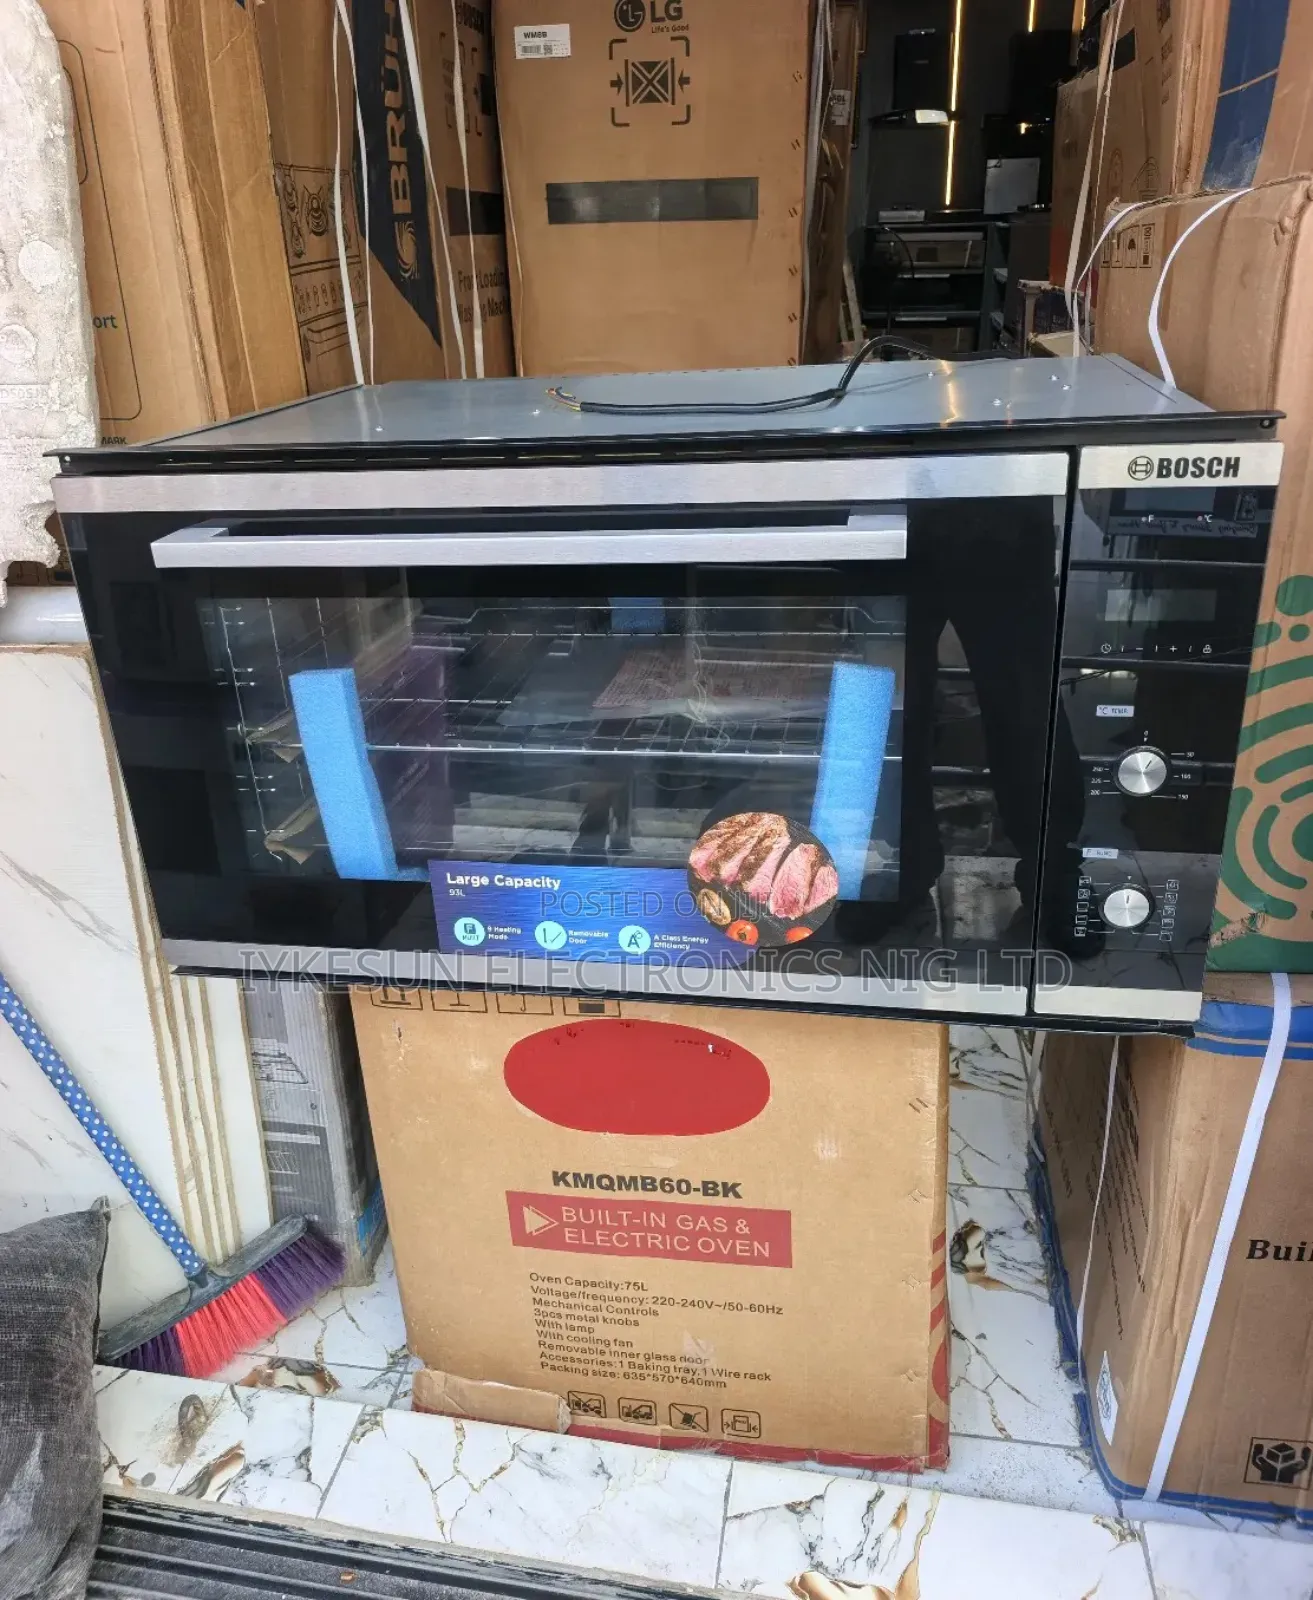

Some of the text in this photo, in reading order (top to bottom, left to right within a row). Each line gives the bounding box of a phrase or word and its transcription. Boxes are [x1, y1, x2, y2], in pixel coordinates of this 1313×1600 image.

[650, 0, 683, 22] LG
[651, 24, 690, 33] Life's Good
[93, 315, 118, 329] ort
[1156, 456, 1240, 479] BOSCH
[446, 872, 561, 891] Large Capacity
[449, 889, 466, 897] 93L
[494, 926, 522, 935] Heating
[568, 930, 609, 938] Removable
[568, 937, 587, 945] Door
[653, 941, 691, 951] Efficiency
[662, 934, 681, 942] Class
[682, 936, 709, 945] Energy
[551, 1170, 743, 1199] KMQMB60-BK
[561, 1206, 750, 1234] BUILT-IN GAS &
[564, 1228, 770, 1258] ELECTRIC OVEN
[529, 1272, 562, 1285] Oven
[532, 1297, 660, 1317] Mechanical Controls
[534, 1308, 640, 1327] 3pcs metal knobs
[534, 1318, 595, 1334] With lamp
[536, 1329, 634, 1348] With cooling fan
[538, 1340, 709, 1365] Removable inner glass door
[540, 1361, 589, 1377] Packing
[628, 1361, 671, 1374] Baking
[711, 1368, 741, 1379] Wire
[743, 1371, 772, 1381] rack
